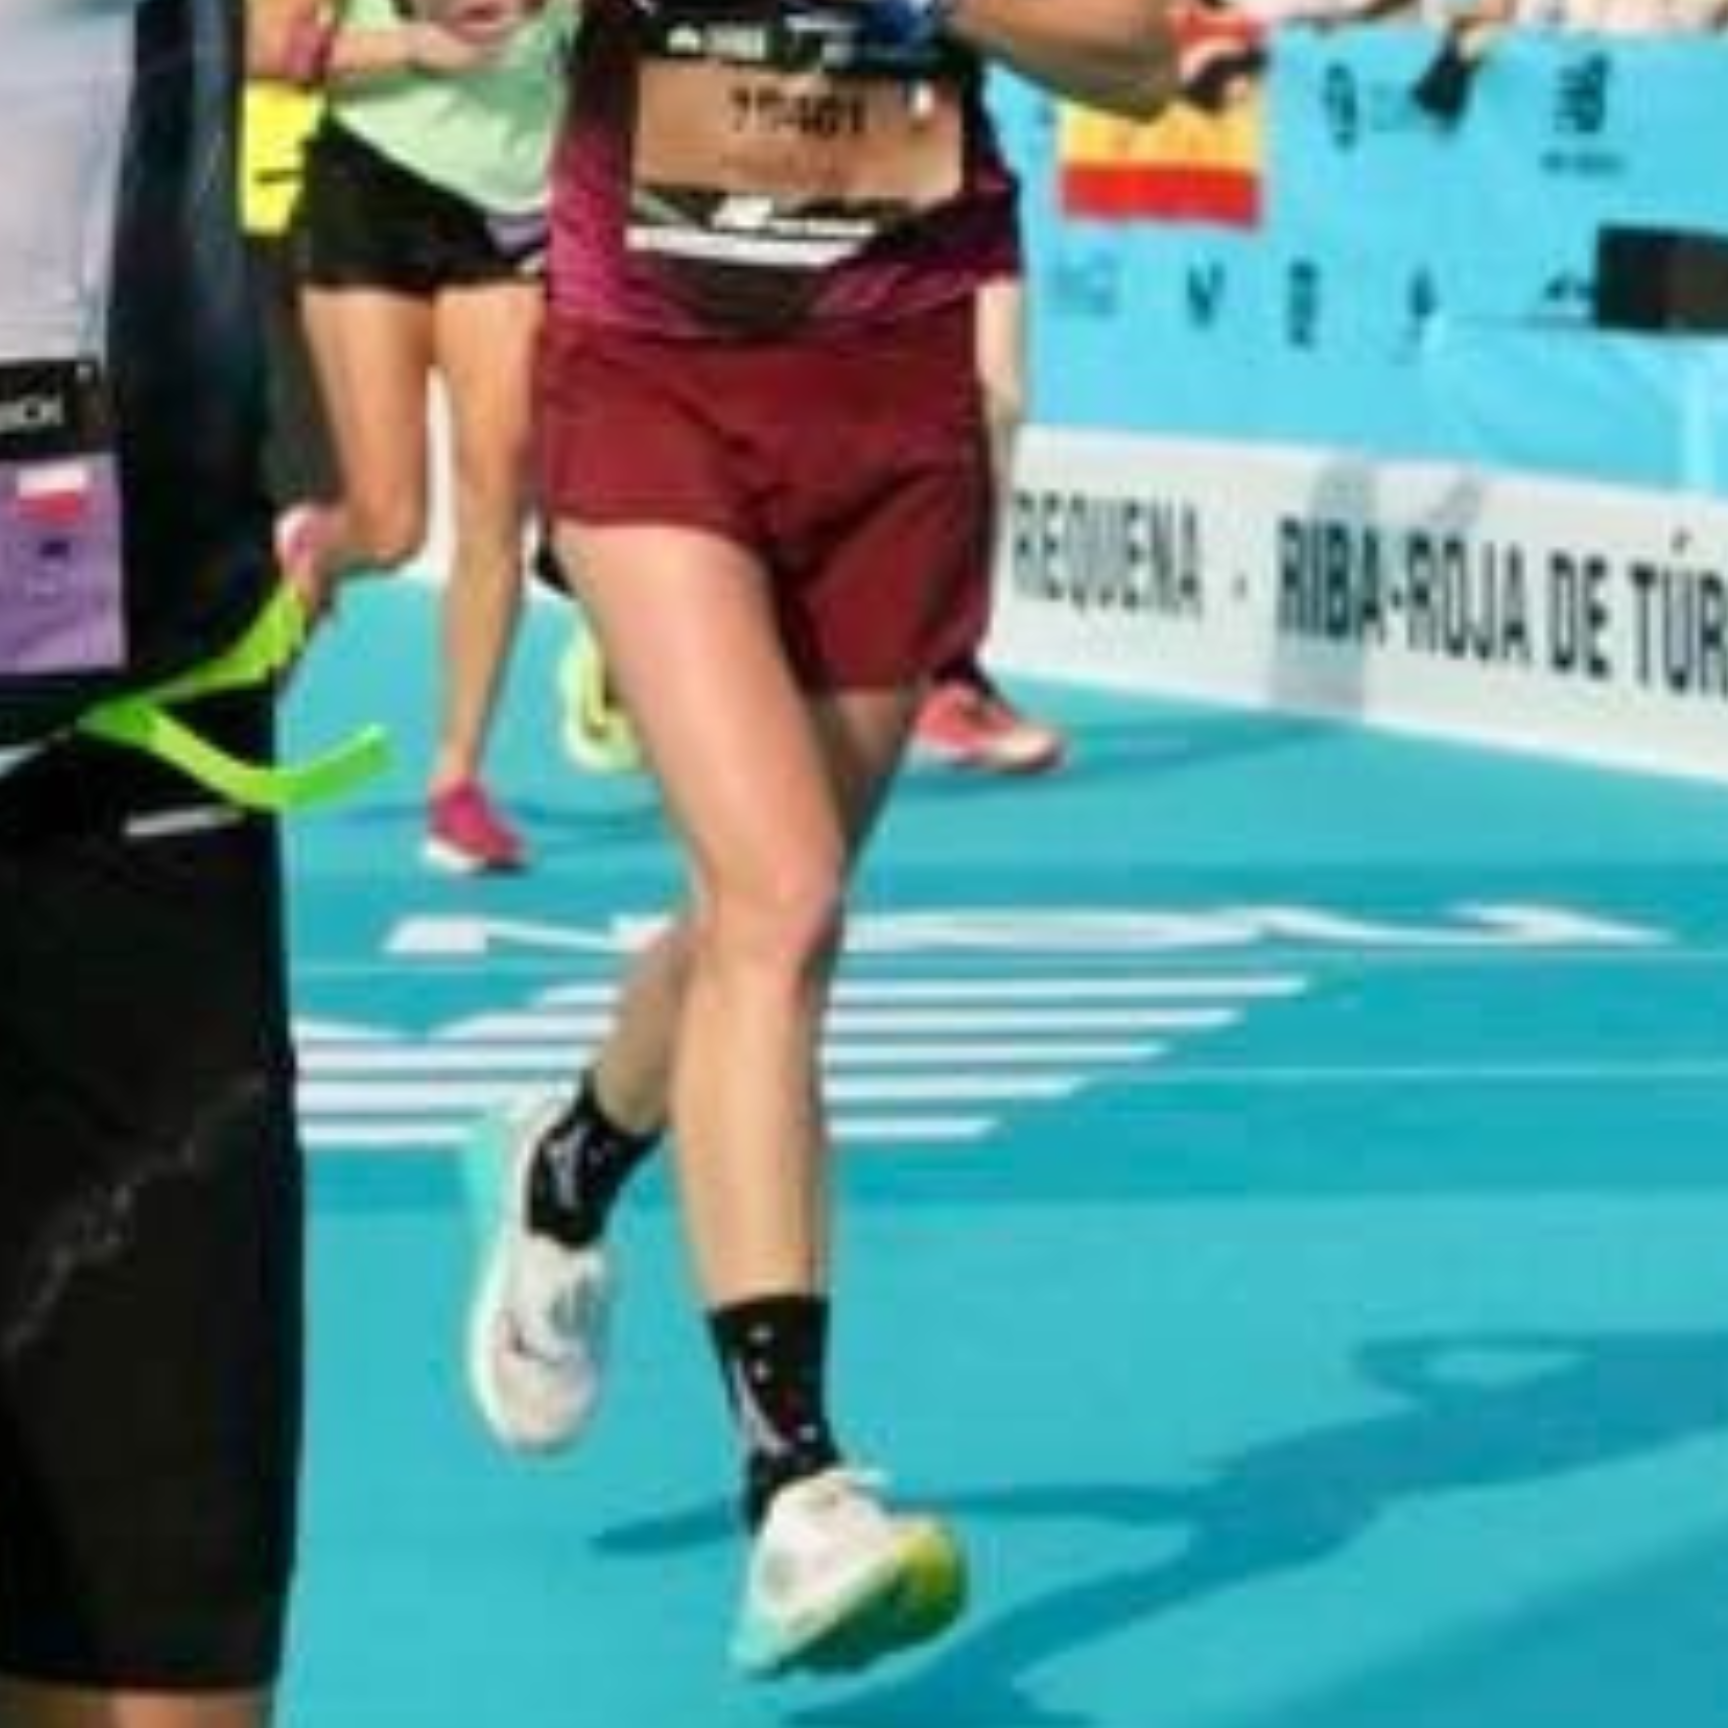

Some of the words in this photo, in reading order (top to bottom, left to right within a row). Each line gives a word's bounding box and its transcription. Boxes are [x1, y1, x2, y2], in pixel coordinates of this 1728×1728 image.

[1014, 491, 1203, 618] REQUENA
[1277, 515, 1530, 669] RIBA-ROJA
[1547, 551, 1609, 682] DE
